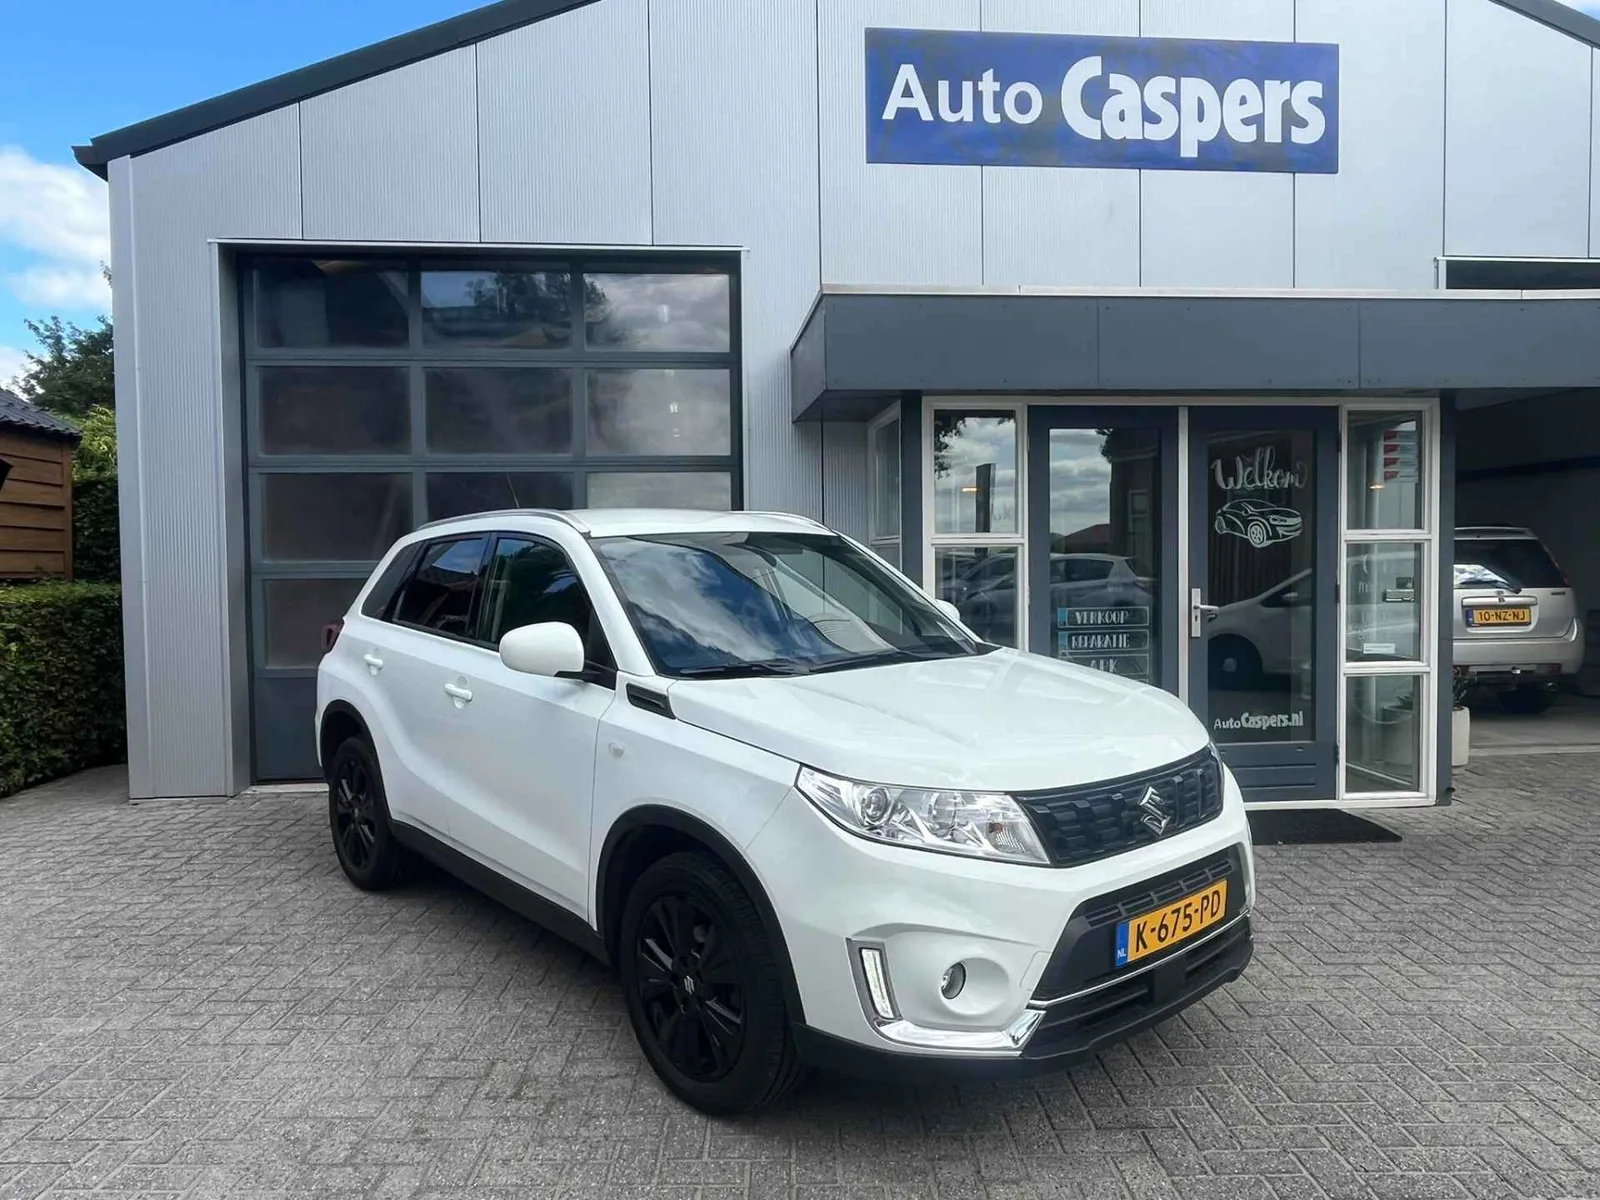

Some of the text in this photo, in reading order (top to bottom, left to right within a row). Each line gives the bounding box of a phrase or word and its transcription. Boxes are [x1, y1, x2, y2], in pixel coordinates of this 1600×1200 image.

[881, 55, 1326, 158] Auto Caspers
[1210, 445, 1308, 490] Welkom
[1075, 609, 1129, 625] VERKOOP
[1478, 610, 1526, 622] 10-NZ-NJ
[1071, 633, 1130, 649] REPARATIE
[1117, 889, 1221, 959] NL K-675-PD
